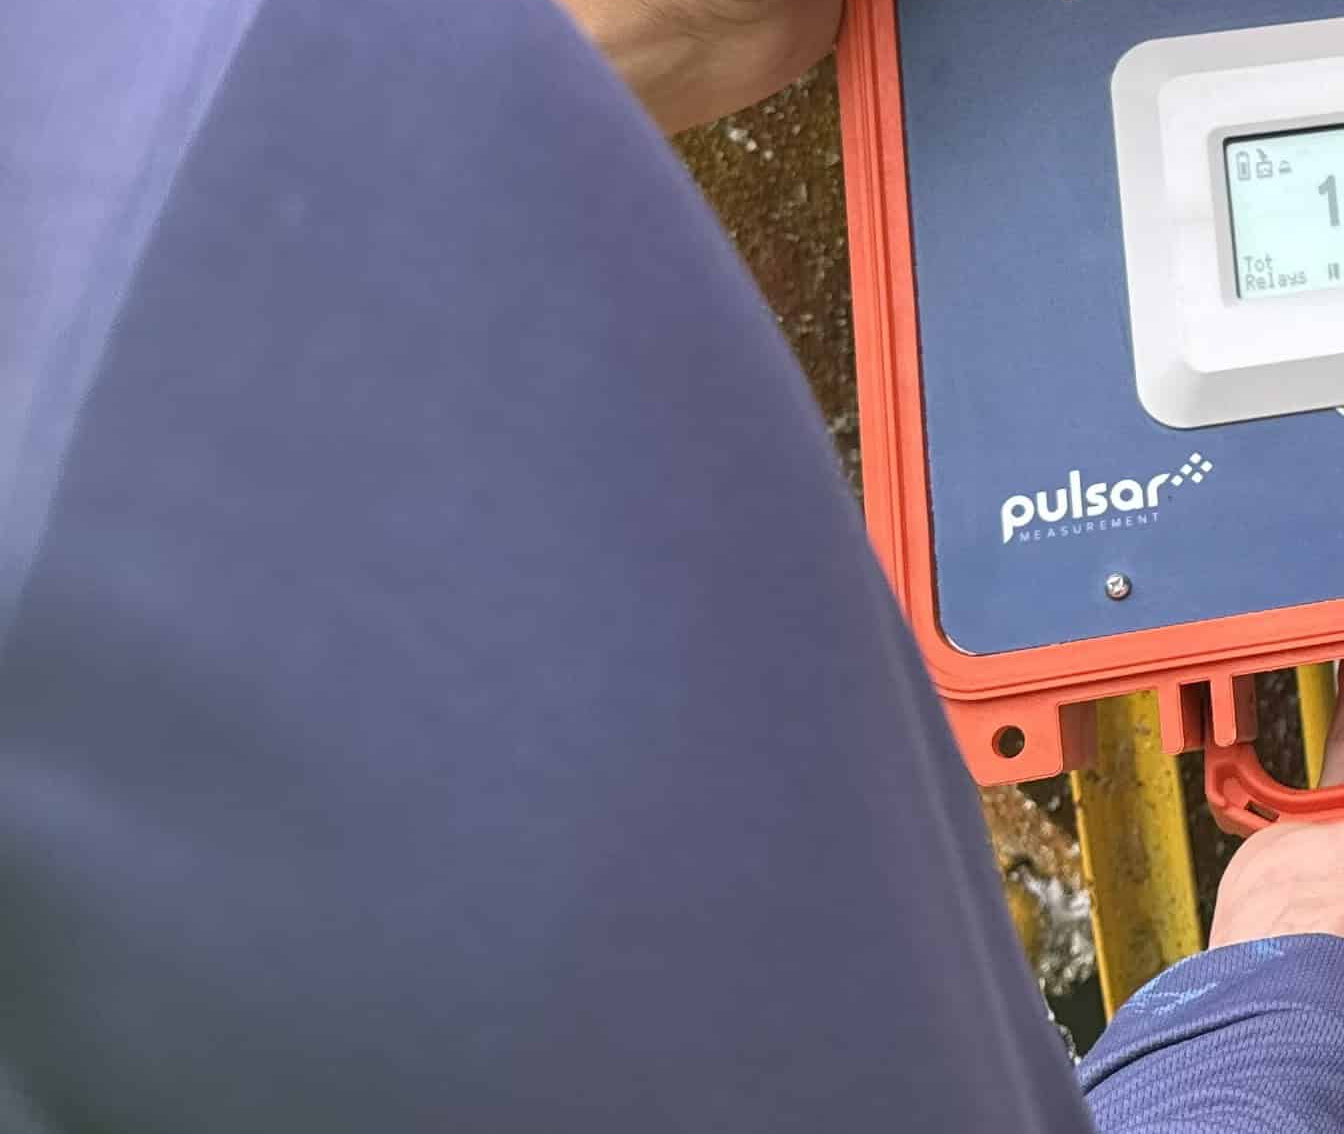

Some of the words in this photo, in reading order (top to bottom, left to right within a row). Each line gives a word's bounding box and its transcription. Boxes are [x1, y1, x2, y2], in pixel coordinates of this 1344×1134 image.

[1243, 253, 1274, 274] Tot
[1244, 271, 1308, 292] Relays
[1001, 469, 1171, 545] pulsar
[1019, 511, 1160, 543] MEASUREMENT
